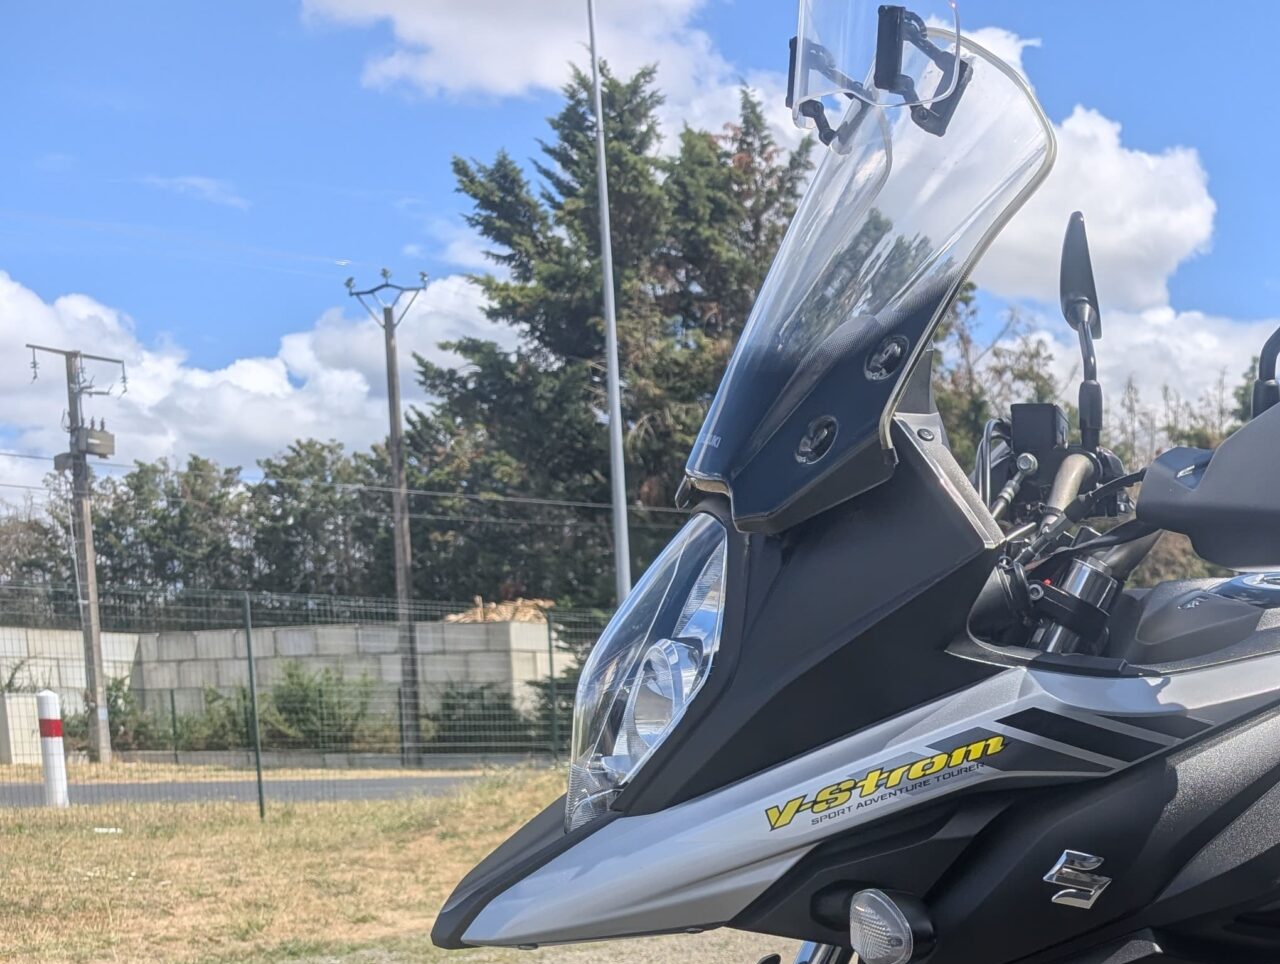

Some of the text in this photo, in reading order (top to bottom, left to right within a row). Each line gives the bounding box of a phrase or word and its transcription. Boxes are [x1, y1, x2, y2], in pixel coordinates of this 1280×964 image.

[764, 735, 1009, 831] V-Strom
[811, 762, 985, 826] SPORT ADVENTURE TOURER
